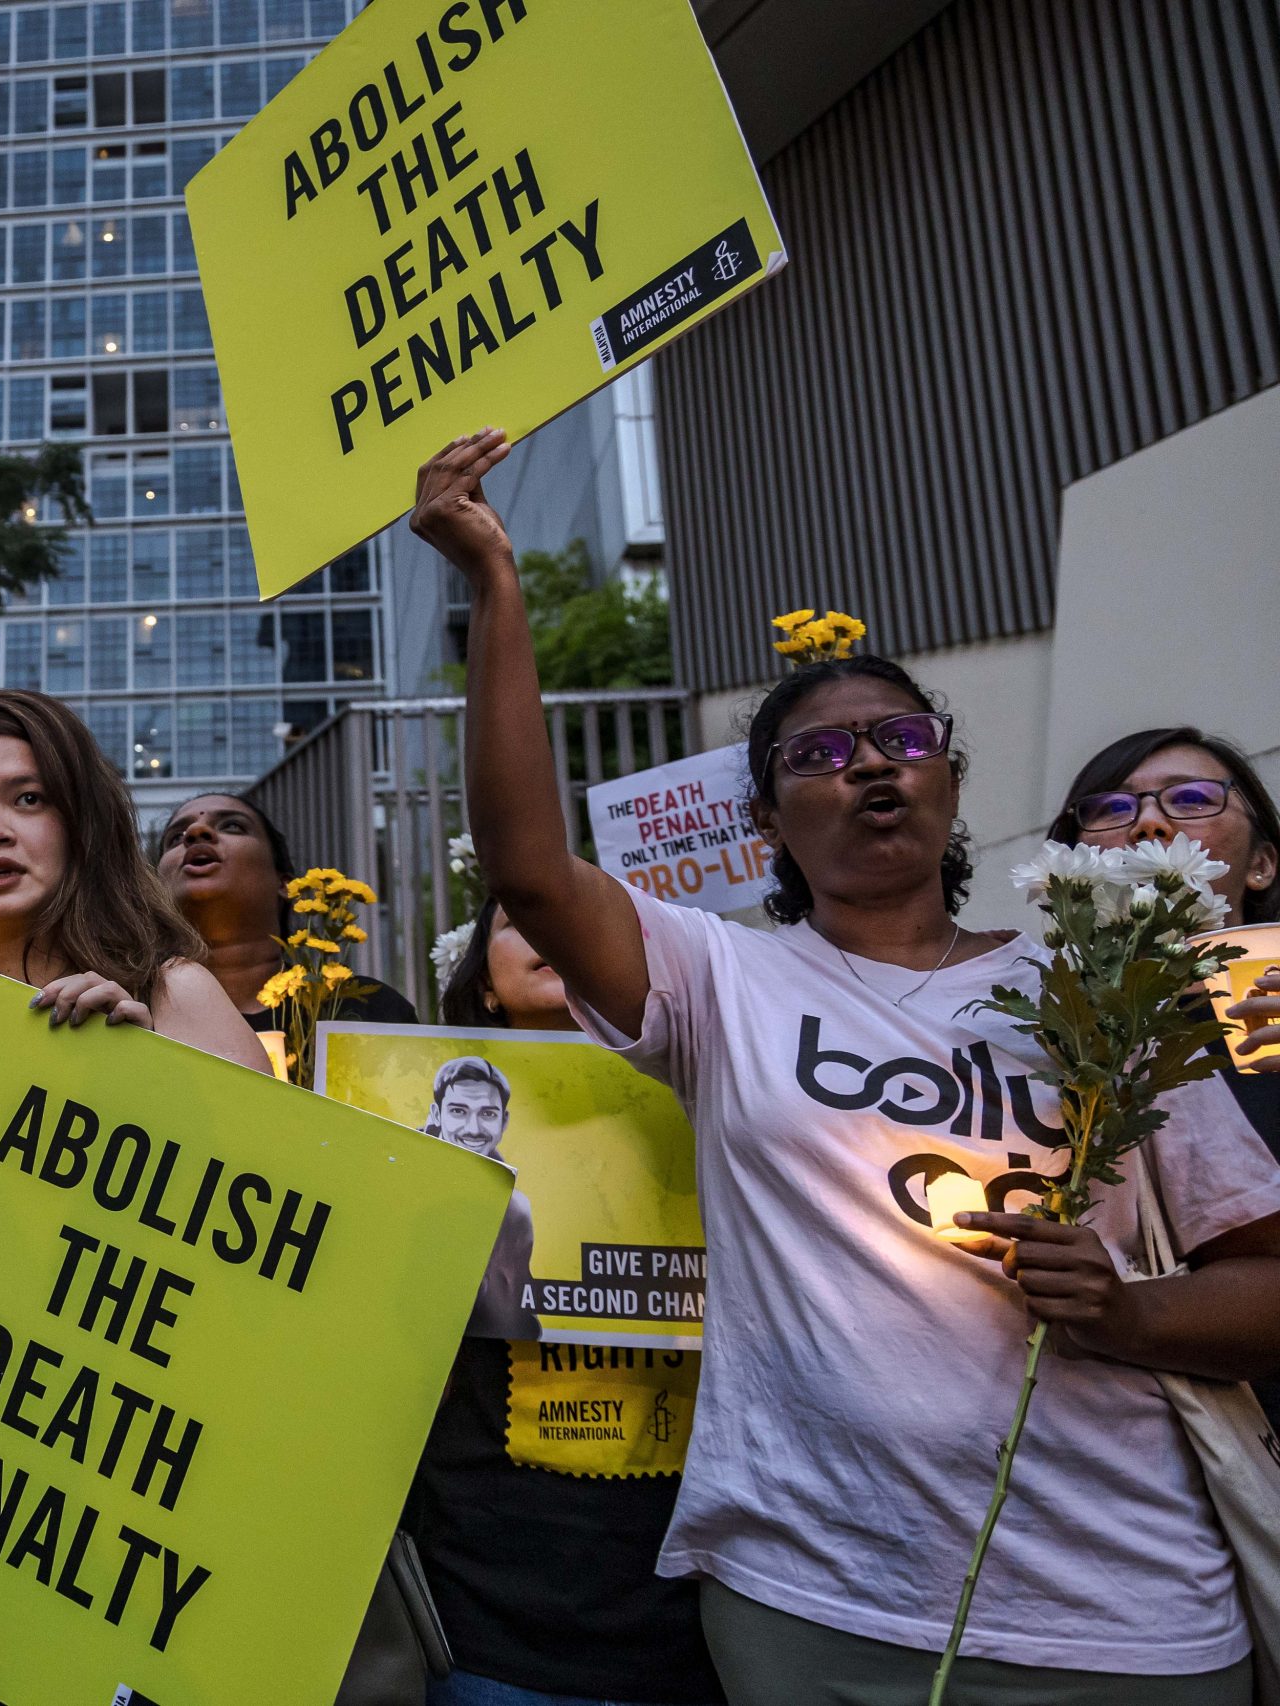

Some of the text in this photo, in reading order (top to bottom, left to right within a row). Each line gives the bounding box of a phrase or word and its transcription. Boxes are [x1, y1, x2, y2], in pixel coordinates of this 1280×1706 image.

[357, 100, 479, 236] THE
[344, 147, 546, 349] DEATH
[620, 266, 696, 333] AMNESTY
[623, 287, 702, 345] INTERNATIONAL
[330, 197, 604, 456] PENALTY
[593, 324, 612, 364] MALAYSIA
[608, 780, 705, 820] THE DEATH
[639, 799, 751, 844] PENALTY IS
[622, 846, 658, 868] ONLY
[662, 836, 697, 858] TIME
[699, 825, 738, 849] THAT
[589, 1250, 643, 1277] GIVE
[46, 1224, 195, 1369] THE
[521, 1284, 536, 1310] A
[543, 1286, 638, 1315] SECOND
[539, 1400, 624, 1423] AMNESTY
[539, 1426, 626, 1440] INTERNATIONAL
